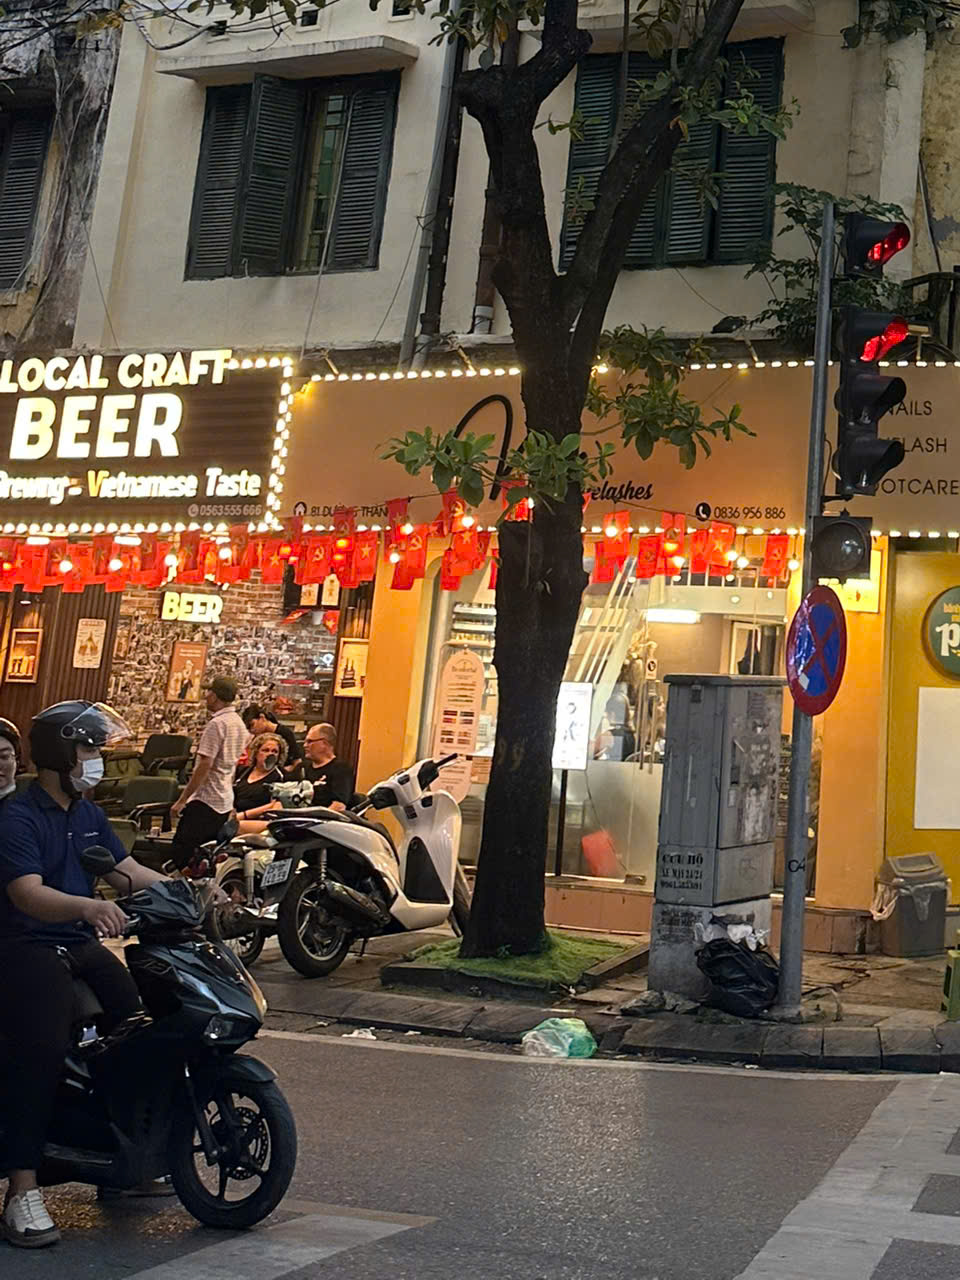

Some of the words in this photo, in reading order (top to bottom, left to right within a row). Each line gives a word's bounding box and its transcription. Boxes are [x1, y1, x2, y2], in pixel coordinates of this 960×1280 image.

[0, 356, 109, 393] LOCAL
[117, 349, 232, 388] CRAFT
[9, 393, 183, 460] BEER
[87, 469, 199, 498] Vietnamese
[205, 467, 262, 497] Taste
[714, 506, 741, 519] 0836
[742, 506, 763, 520] 956
[765, 506, 787, 520] 886
[161, 591, 224, 624] BEER
